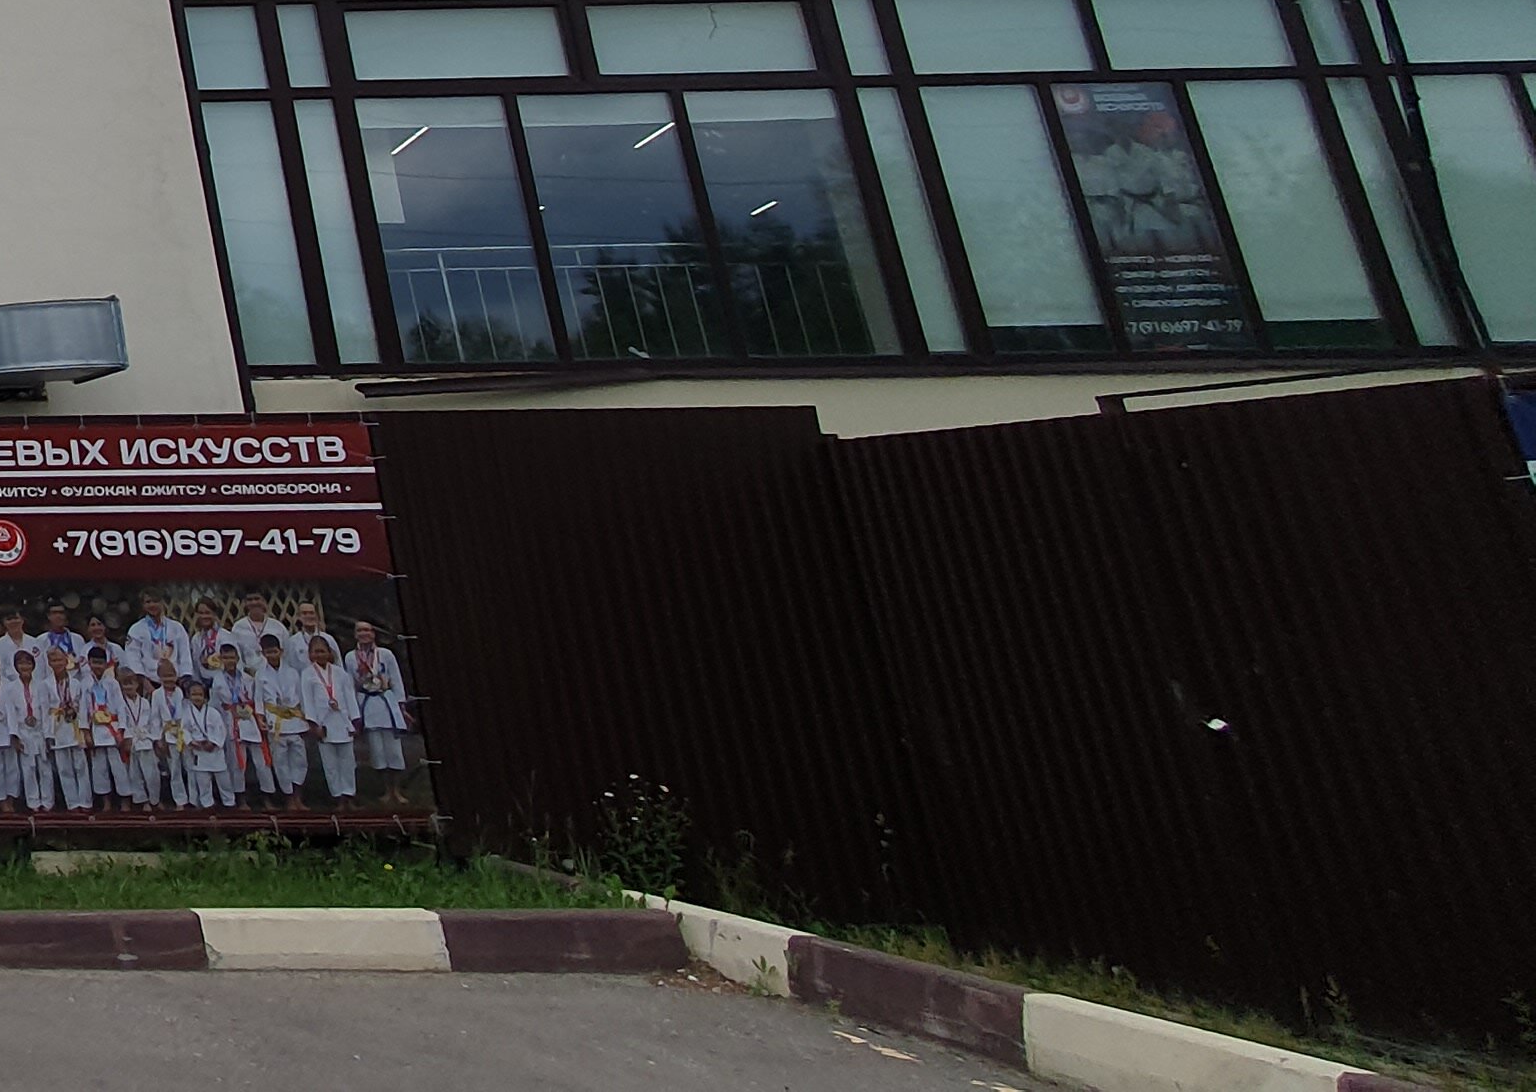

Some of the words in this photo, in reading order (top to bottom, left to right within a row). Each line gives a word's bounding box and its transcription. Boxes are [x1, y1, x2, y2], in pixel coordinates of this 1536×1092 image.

[119, 436, 347, 465] ИСКУССТВ
[60, 485, 138, 497] ФУДОКАН
[141, 484, 207, 497] ДЖИТСУ
[220, 483, 342, 495] САМООБОРОНА
[52, 528, 362, 560] +7(916)697-41-79
